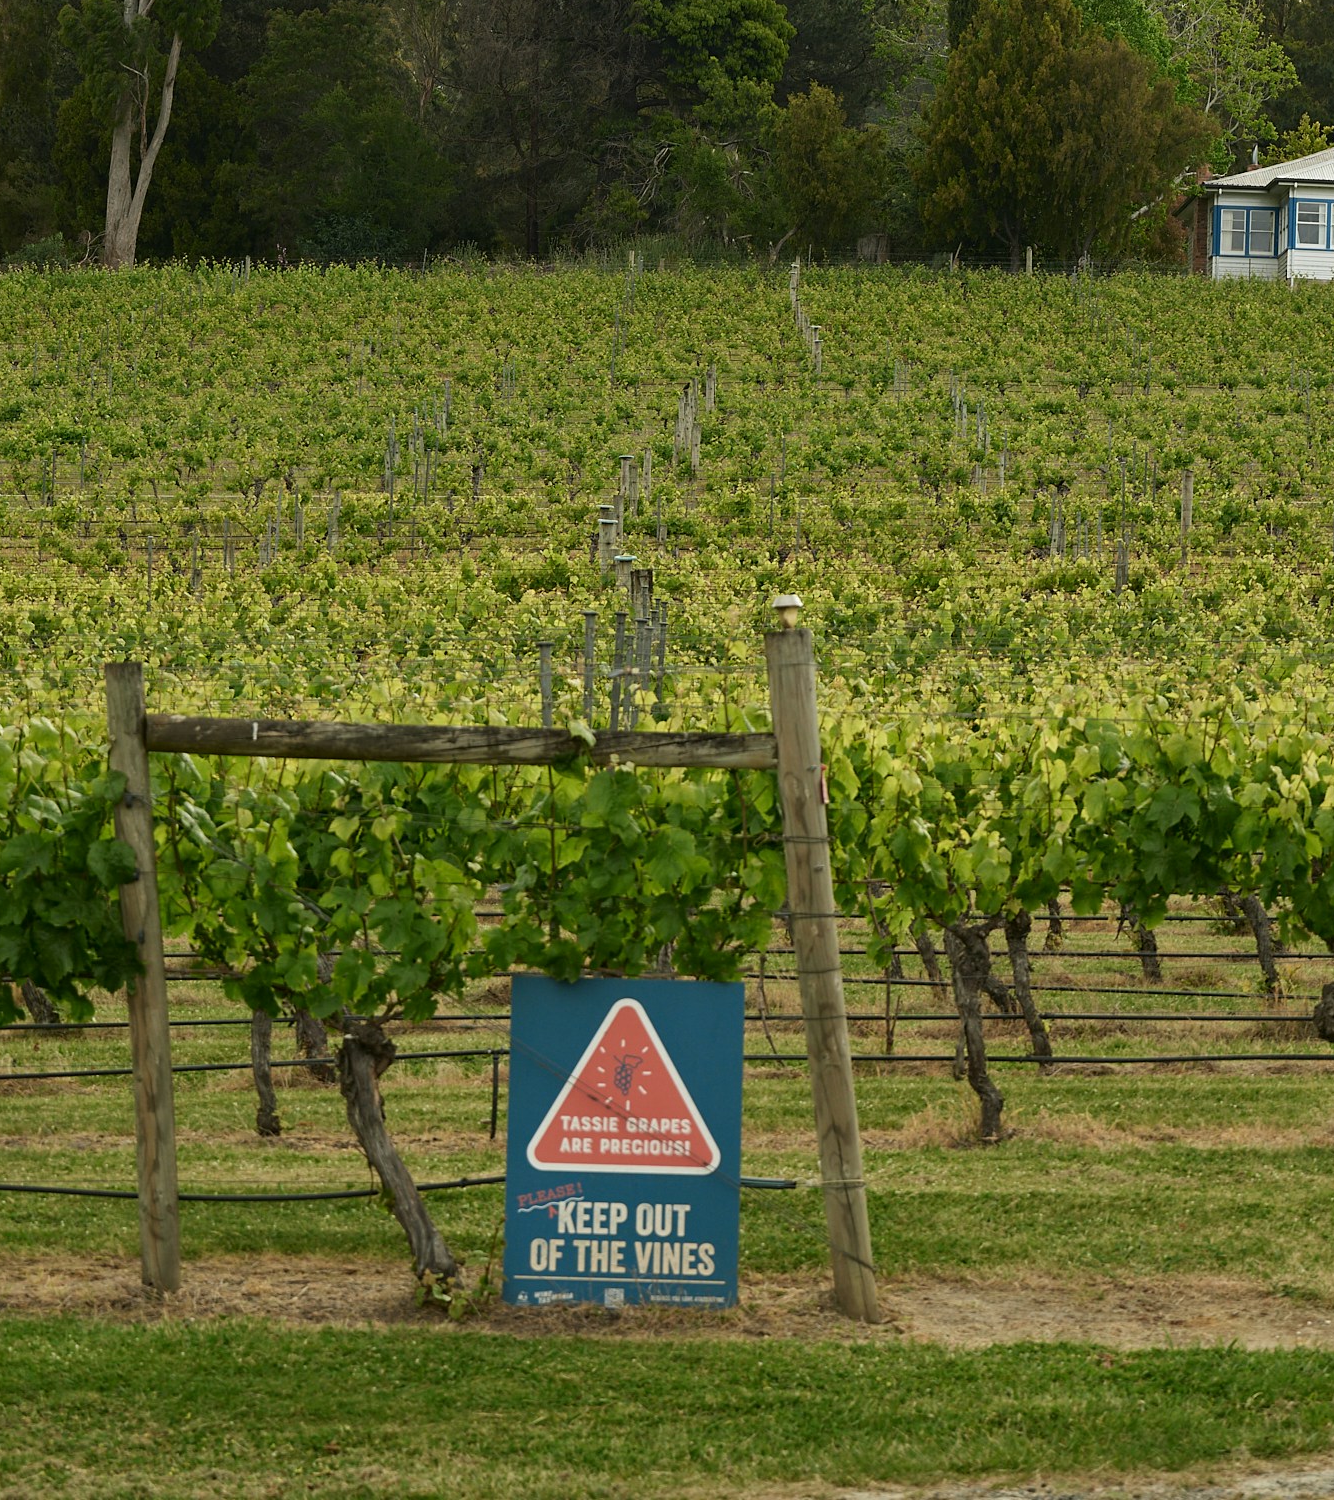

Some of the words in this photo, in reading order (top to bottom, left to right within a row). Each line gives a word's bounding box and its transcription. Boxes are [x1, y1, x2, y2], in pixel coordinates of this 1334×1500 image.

[560, 1115, 619, 1132] TASSIE
[626, 1117, 692, 1134] GRAPES
[559, 1137, 593, 1153] ARE
[599, 1138, 691, 1155] PRECIOUS!
[557, 1201, 629, 1235] KEEP
[635, 1203, 692, 1237] OUT
[529, 1238, 566, 1272] OF
[572, 1239, 627, 1273] THE
[634, 1241, 716, 1276] VINES
